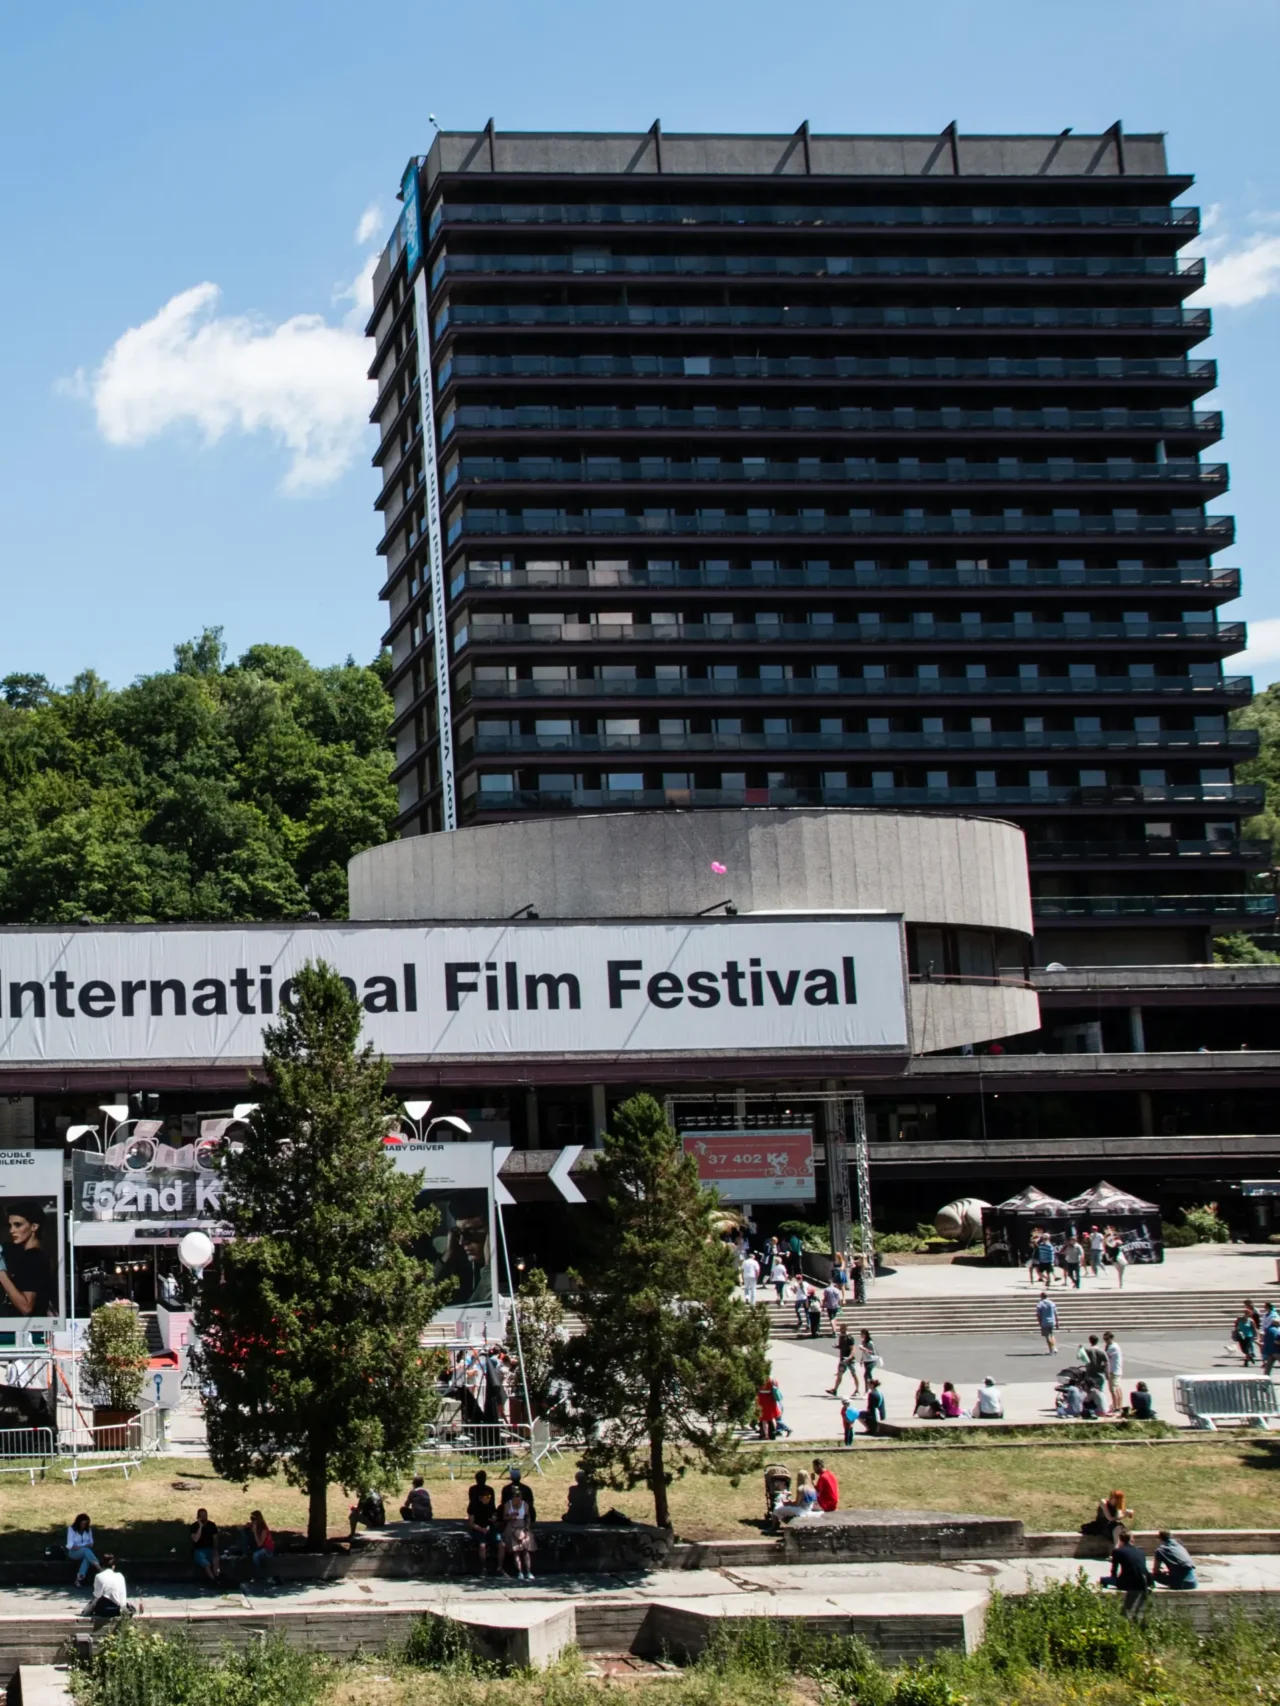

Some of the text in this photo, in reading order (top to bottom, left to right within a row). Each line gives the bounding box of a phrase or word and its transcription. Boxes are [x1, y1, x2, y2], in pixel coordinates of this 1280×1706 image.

[423, 369, 433, 466] Festival
[432, 533, 448, 696] International
[442, 705, 451, 761] Vary
[445, 962, 581, 1011] Film
[608, 957, 857, 1009] Festival
[707, 1154, 727, 1164] 37
[732, 1154, 763, 1164] 402
[93, 1179, 222, 1212] 52nd K
